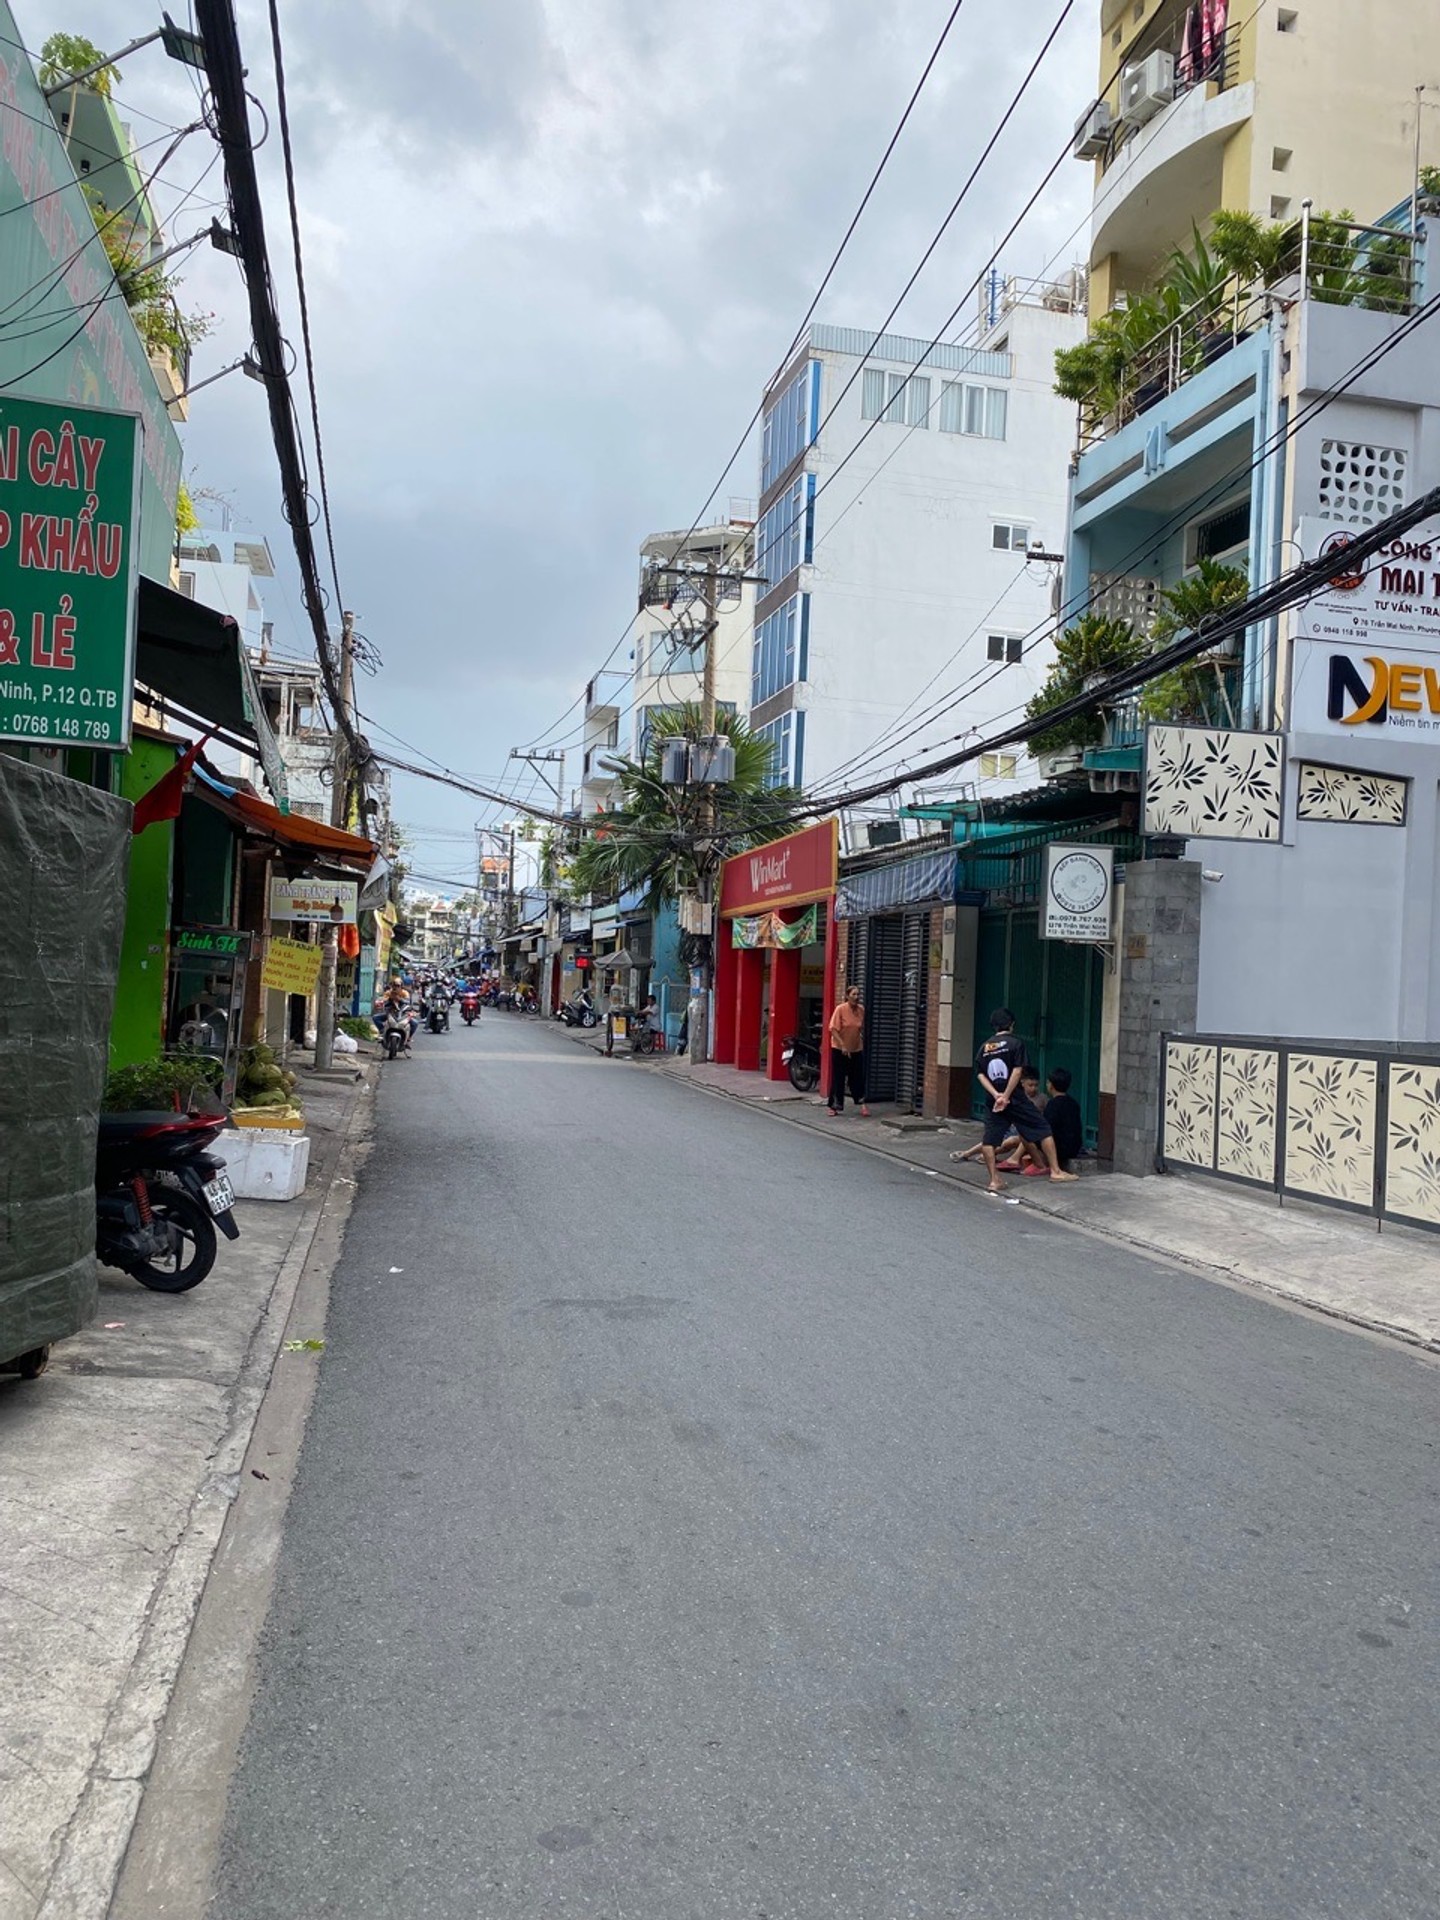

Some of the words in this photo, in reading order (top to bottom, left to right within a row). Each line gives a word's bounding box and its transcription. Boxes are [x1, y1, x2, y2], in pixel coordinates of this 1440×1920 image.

[28, 420, 106, 492] CÂY
[19, 493, 123, 579] KHẨU
[1381, 567, 1424, 595] MAI
[1374, 600, 1390, 611] TƯ
[1391, 600, 1413, 614] VẤN
[31, 593, 77, 671] LẺ
[42, 684, 75, 704] P.12
[79, 688, 117, 709] Q.TB
[13, 714, 48, 734] 0768
[54, 718, 79, 736] 148
[84, 720, 110, 740] 789
[177, 931, 213, 950] Sinh
